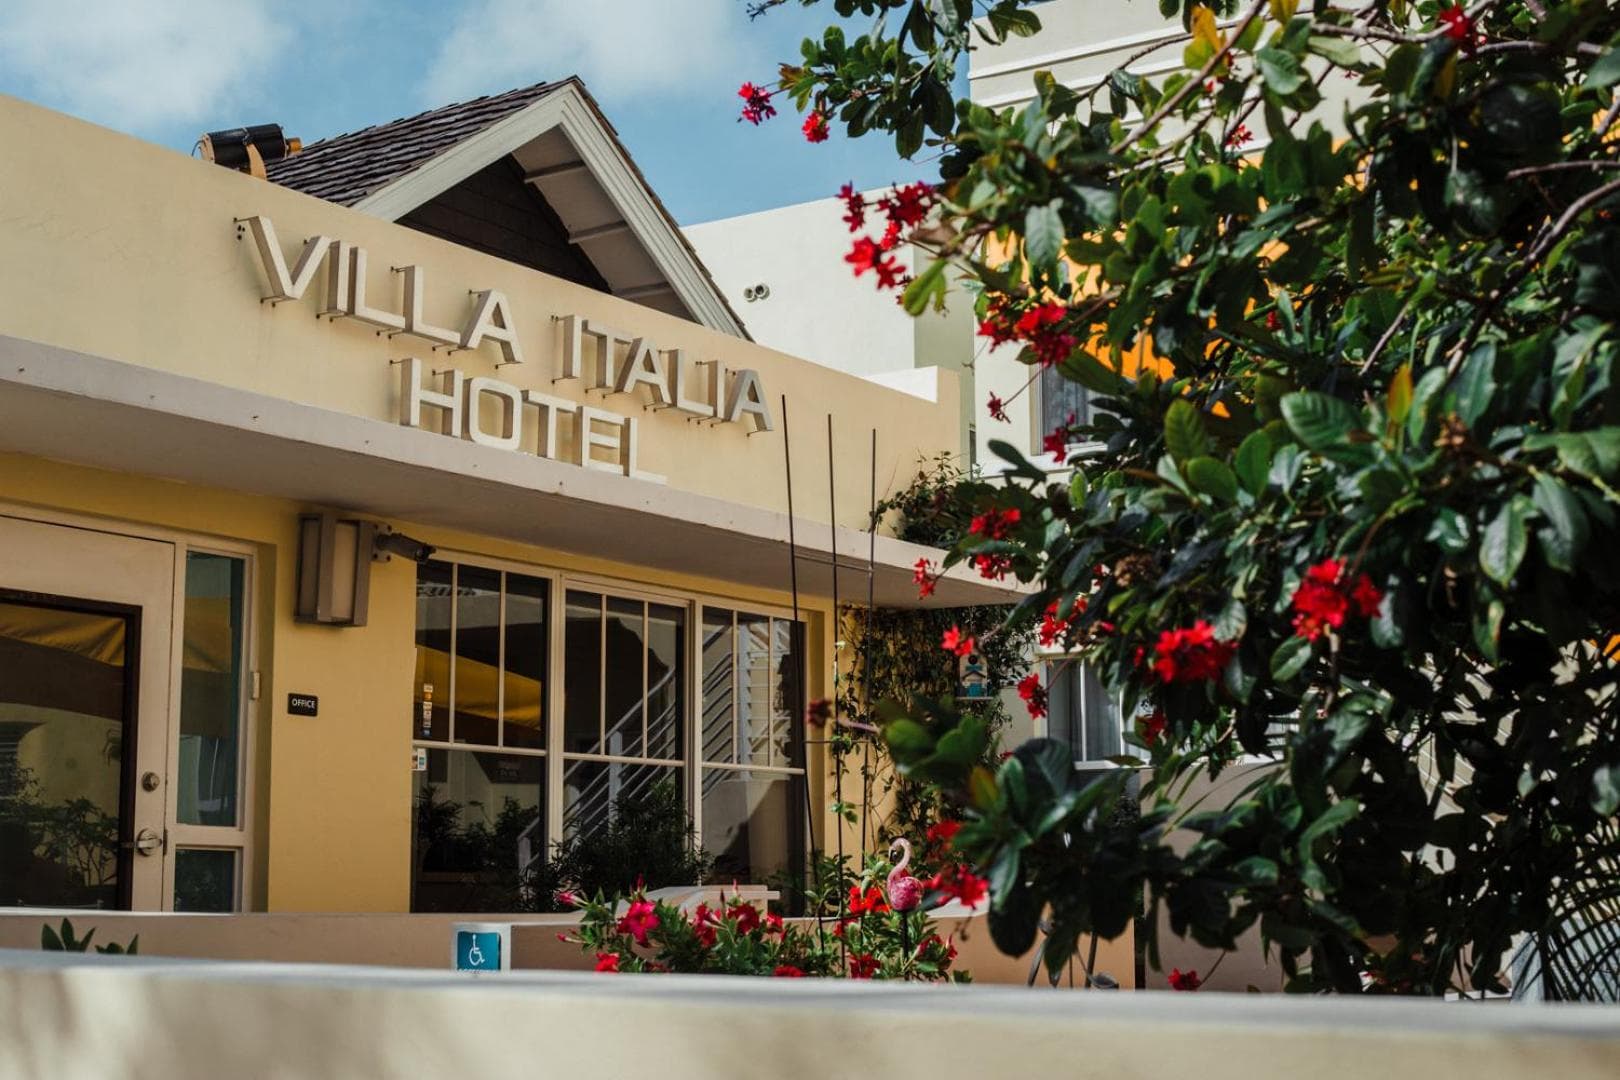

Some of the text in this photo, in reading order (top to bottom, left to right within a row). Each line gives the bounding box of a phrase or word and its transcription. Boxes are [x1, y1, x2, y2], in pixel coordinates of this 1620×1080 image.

[249, 216, 774, 432] VILLA ITALIA
[403, 357, 667, 485] HOTEL
[291, 698, 316, 709] OFFICE
